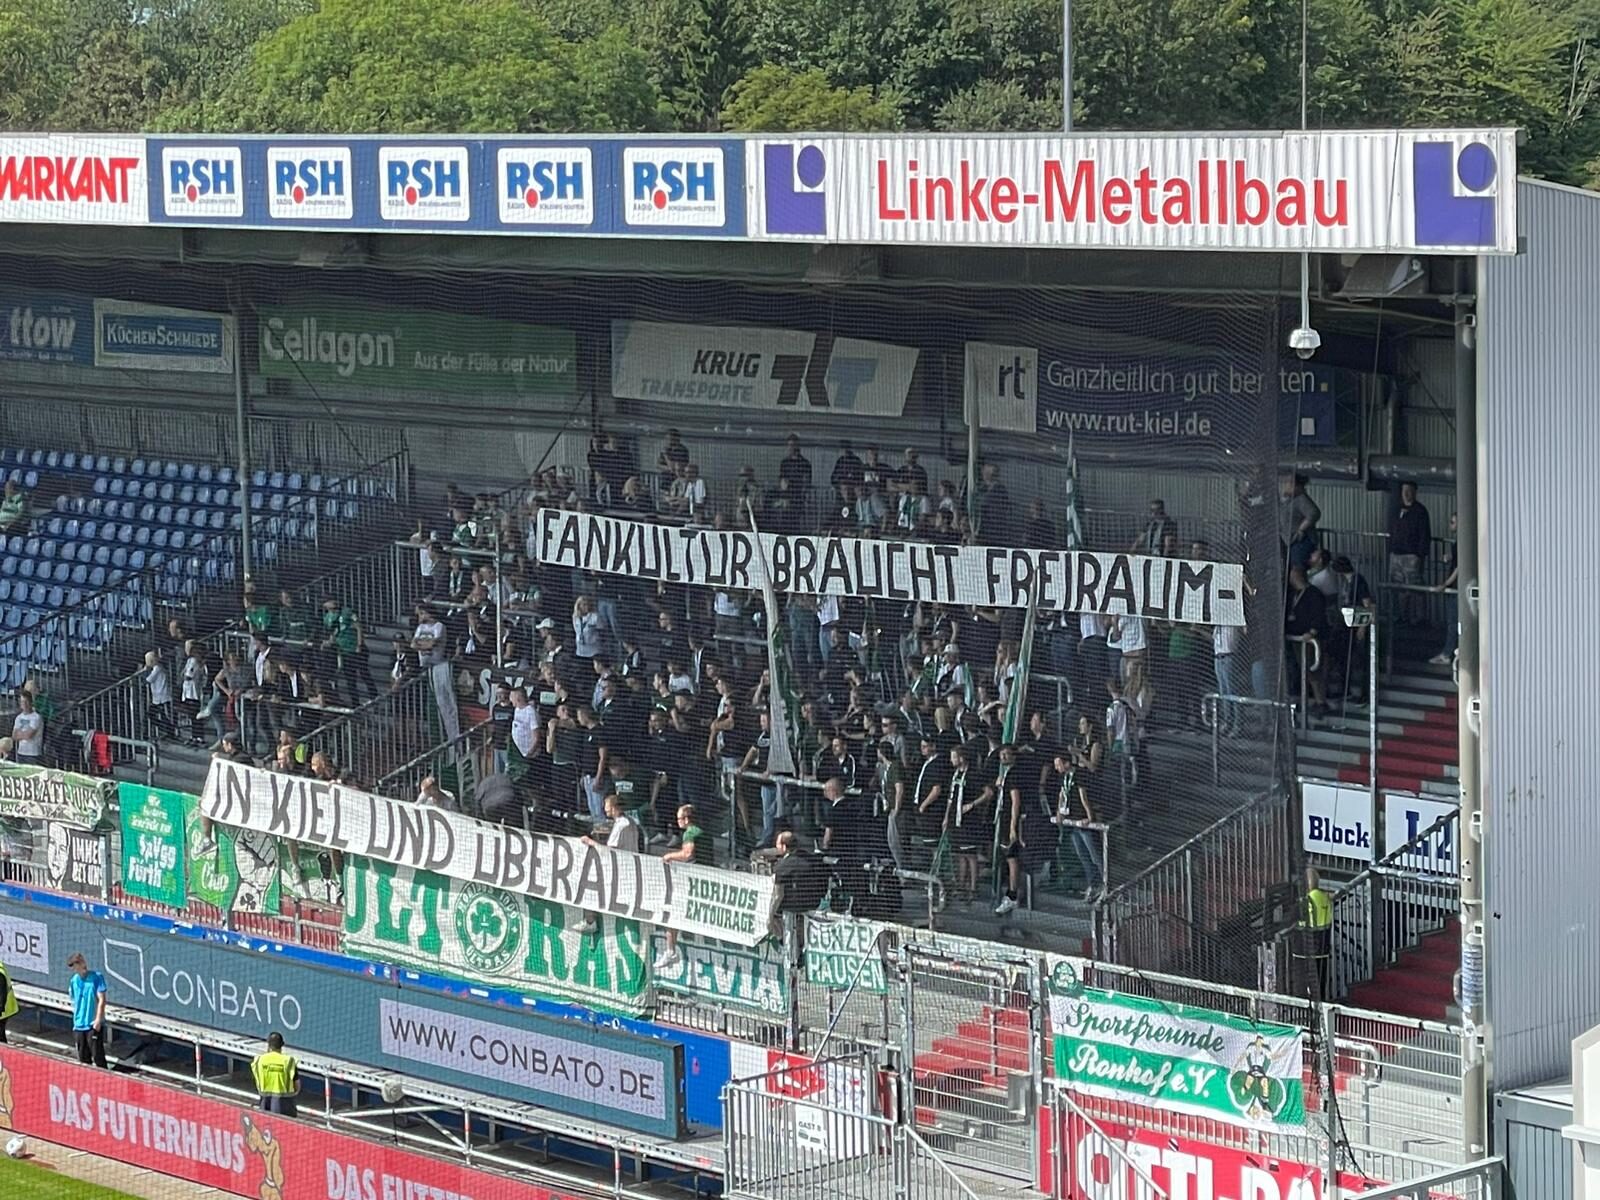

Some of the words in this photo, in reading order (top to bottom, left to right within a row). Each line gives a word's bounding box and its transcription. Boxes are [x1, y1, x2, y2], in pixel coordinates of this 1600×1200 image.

[170, 159, 235, 195] RSH
[275, 159, 346, 197] RSH
[387, 159, 460, 198] RSH
[506, 161, 583, 200] RSH
[633, 161, 715, 201] RSH
[877, 159, 1348, 227] Linke-Metallbau
[263, 317, 395, 377] Cellagon
[414, 351, 438, 371] Aus
[441, 351, 462, 371] der
[502, 353, 524, 373] der
[529, 354, 569, 374] Natur
[692, 349, 761, 378] KRUG
[641, 378, 753, 398] TRANSPORTE
[999, 355, 1026, 400] rt
[1046, 360, 1175, 393] Ganzheitlich
[1183, 370, 1219, 400] gut
[1044, 407, 1211, 436] www.rut-kiel.de
[542, 510, 752, 587] FANKULTUR
[772, 536, 959, 601] BRAUCHT
[986, 547, 1236, 623] FREIRAUM-
[211, 762, 251, 824] IN
[268, 774, 351, 849] KIEL
[366, 796, 456, 870] UND
[473, 819, 673, 924] ÜBERALL!
[1308, 815, 1370, 848] Block
[688, 876, 760, 910] HORIDOS
[685, 901, 756, 935] ENTOURAGE
[150, 965, 301, 1031] CONBATO
[1065, 1001, 1225, 1052] Sportfreunde
[390, 1015, 656, 1100] WWW.CONBATO.DE
[1069, 1044, 1172, 1095] Ronhof
[49, 1084, 94, 1132] DAS
[98, 1097, 245, 1174] FUTTERHAUS
